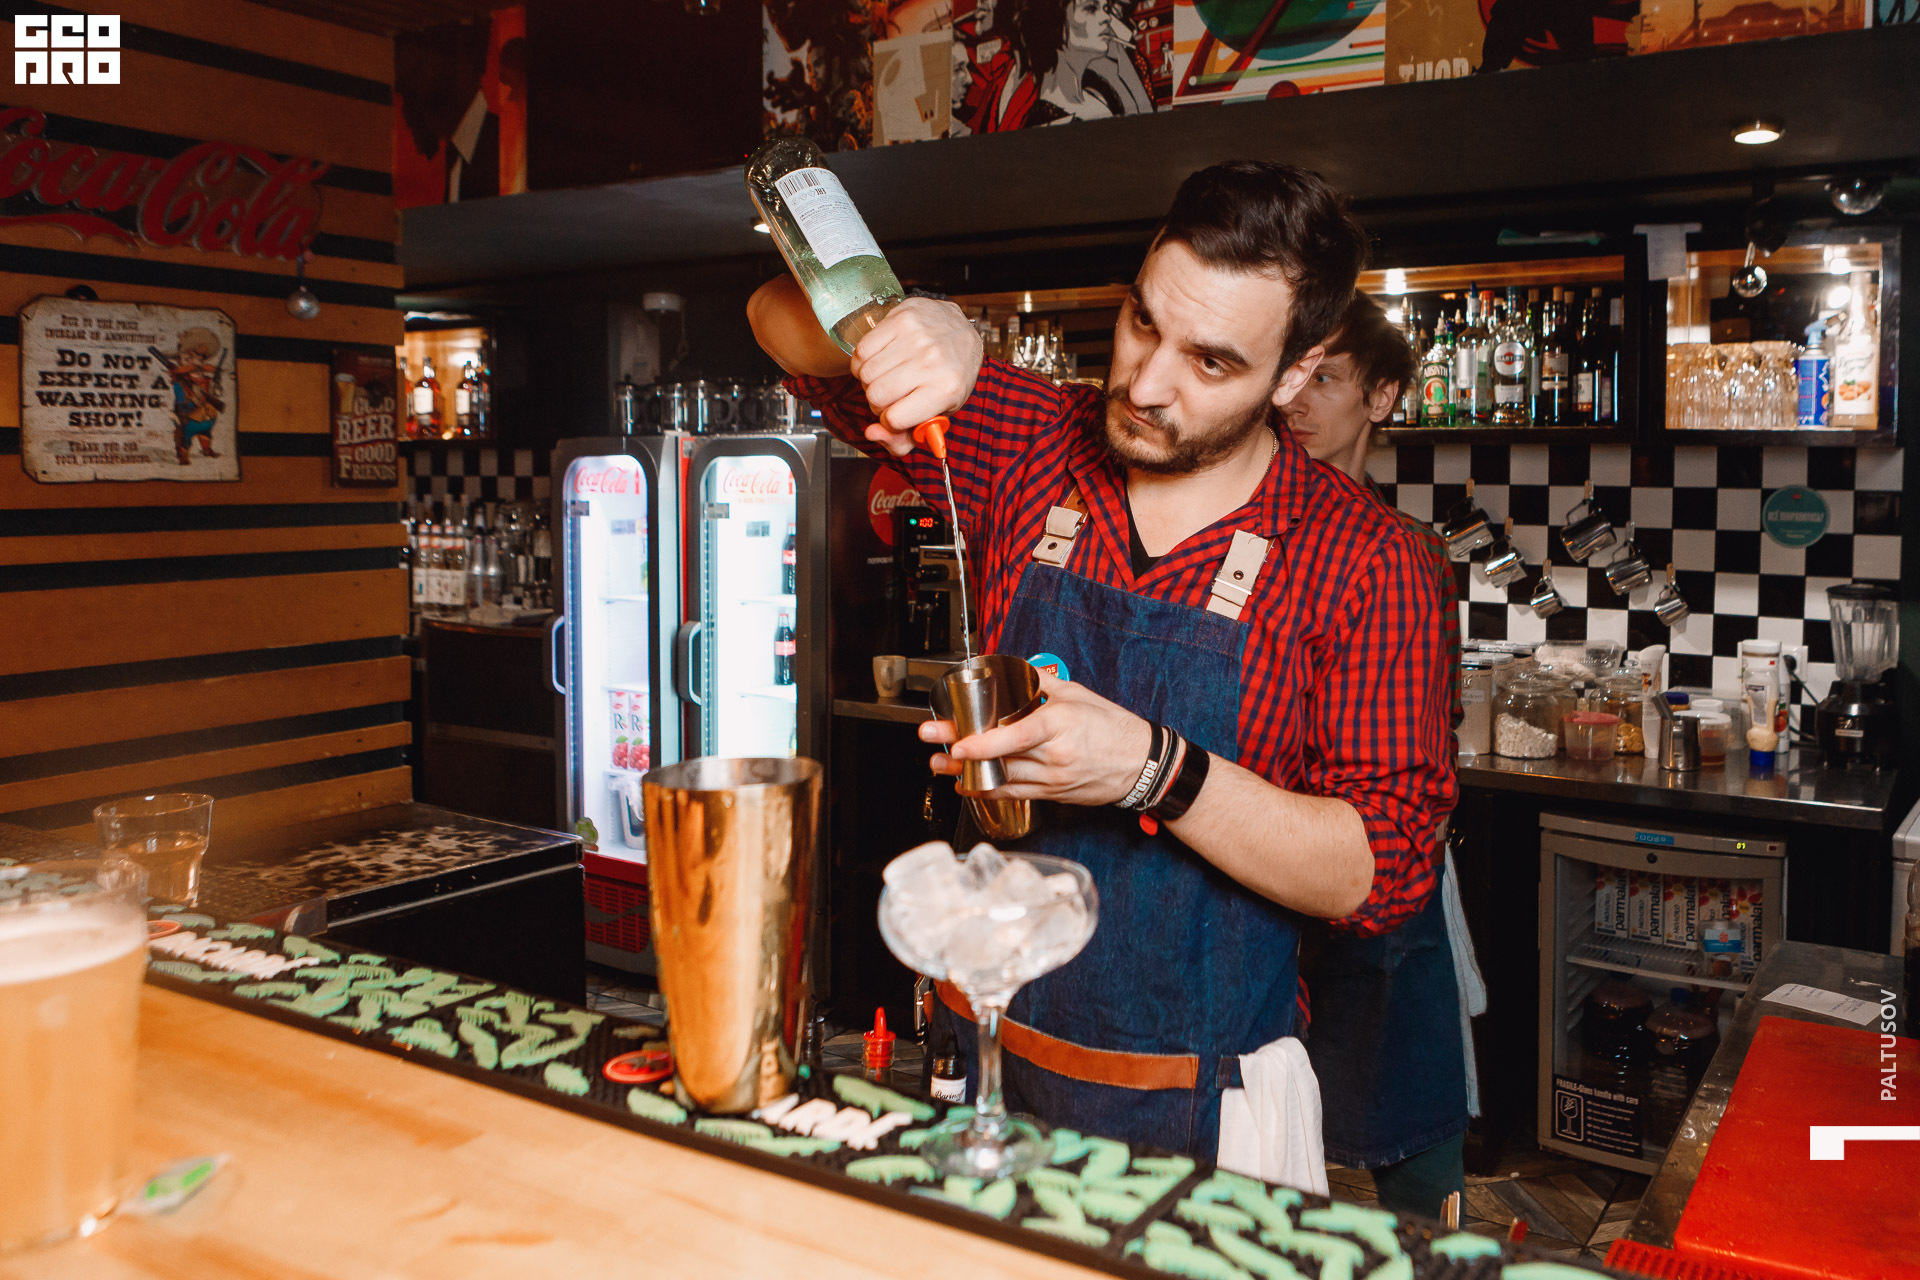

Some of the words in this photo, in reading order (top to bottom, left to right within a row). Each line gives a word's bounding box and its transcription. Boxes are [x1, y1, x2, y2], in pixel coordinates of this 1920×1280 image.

[103, 353, 152, 370] NOT
[38, 370, 140, 389] EXPECT
[151, 375, 169, 390] A
[35, 391, 161, 408] WARNING
[354, 396, 396, 416] GD
[68, 410, 144, 428] SHOT!
[337, 414, 394, 445] BEER
[354, 442, 396, 463] GOOD
[1135, 758, 1159, 792] ROAD
